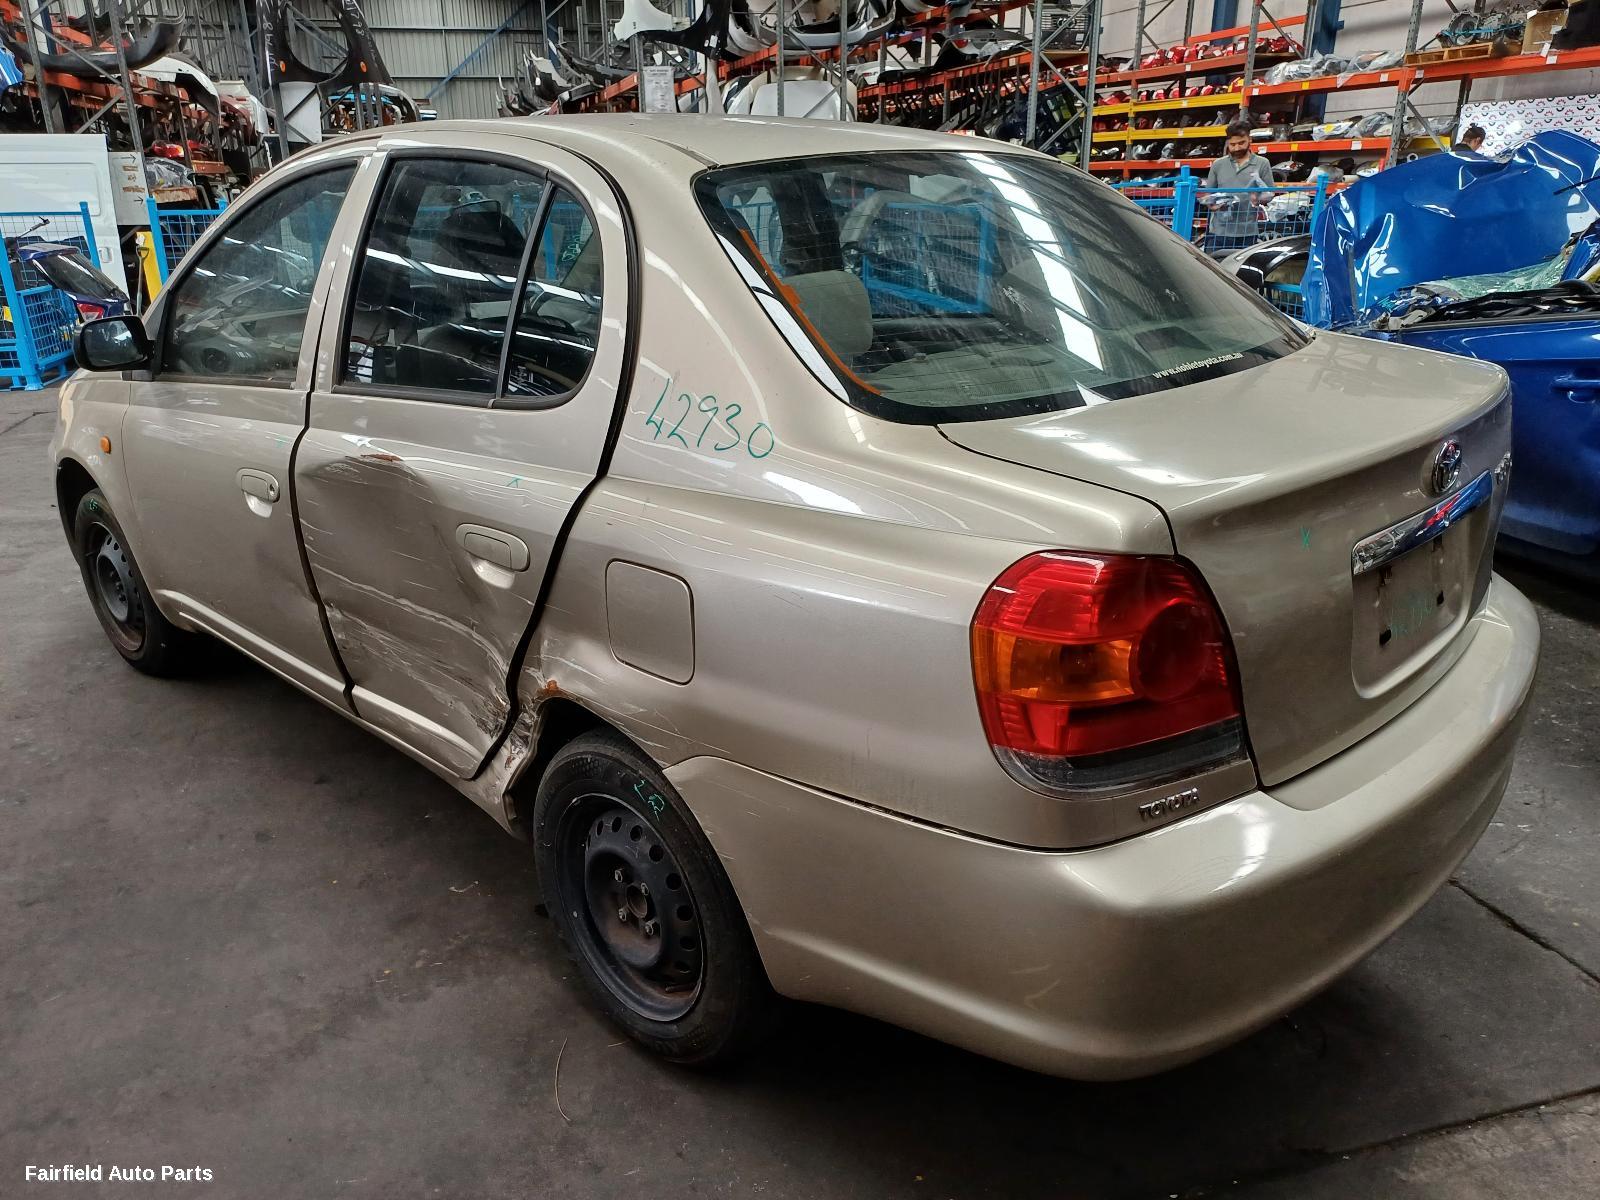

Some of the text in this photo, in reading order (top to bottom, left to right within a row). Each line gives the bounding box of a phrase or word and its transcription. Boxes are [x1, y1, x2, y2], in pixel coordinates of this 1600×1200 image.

[1152, 352, 1244, 379] www.nobletoyota.com.au
[645, 378, 774, 458] 42930
[1139, 787, 1199, 820] TOYOTA
